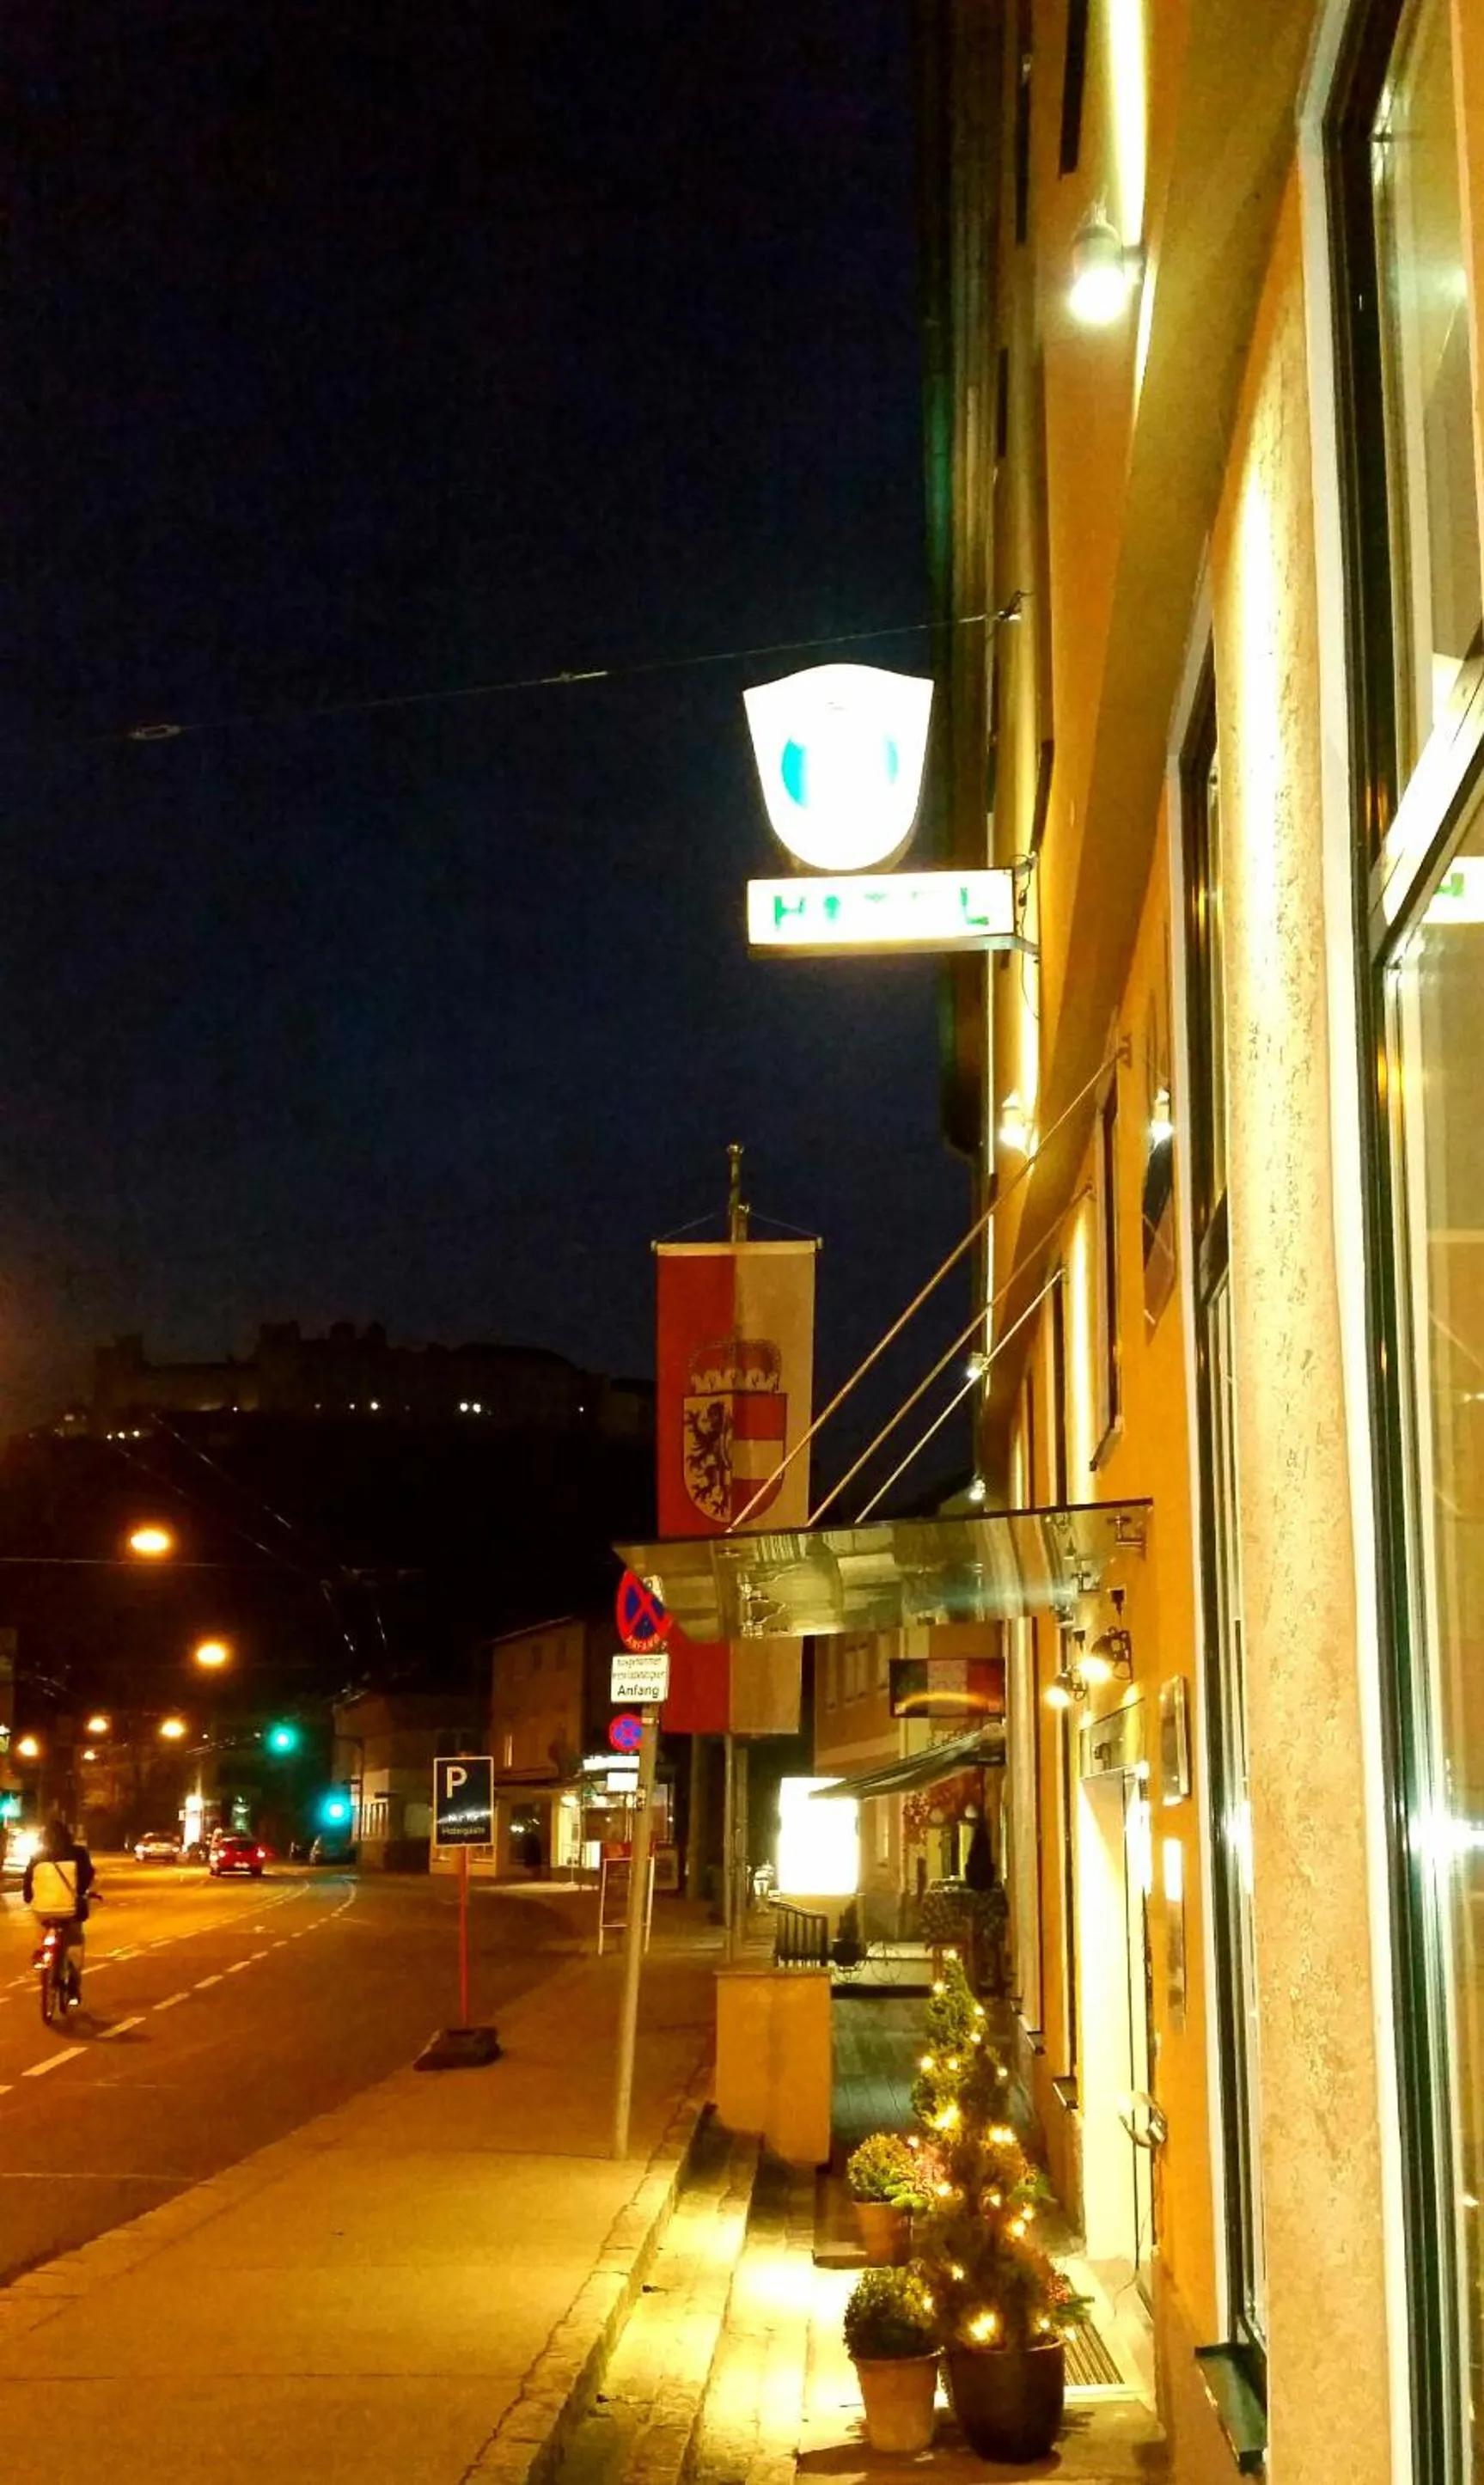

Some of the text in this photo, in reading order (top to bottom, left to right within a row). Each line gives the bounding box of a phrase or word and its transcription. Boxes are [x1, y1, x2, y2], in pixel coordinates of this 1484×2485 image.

[773, 886, 990, 931] HOL
[617, 1684, 659, 1699] Anfang
[447, 1766, 467, 1798] P
